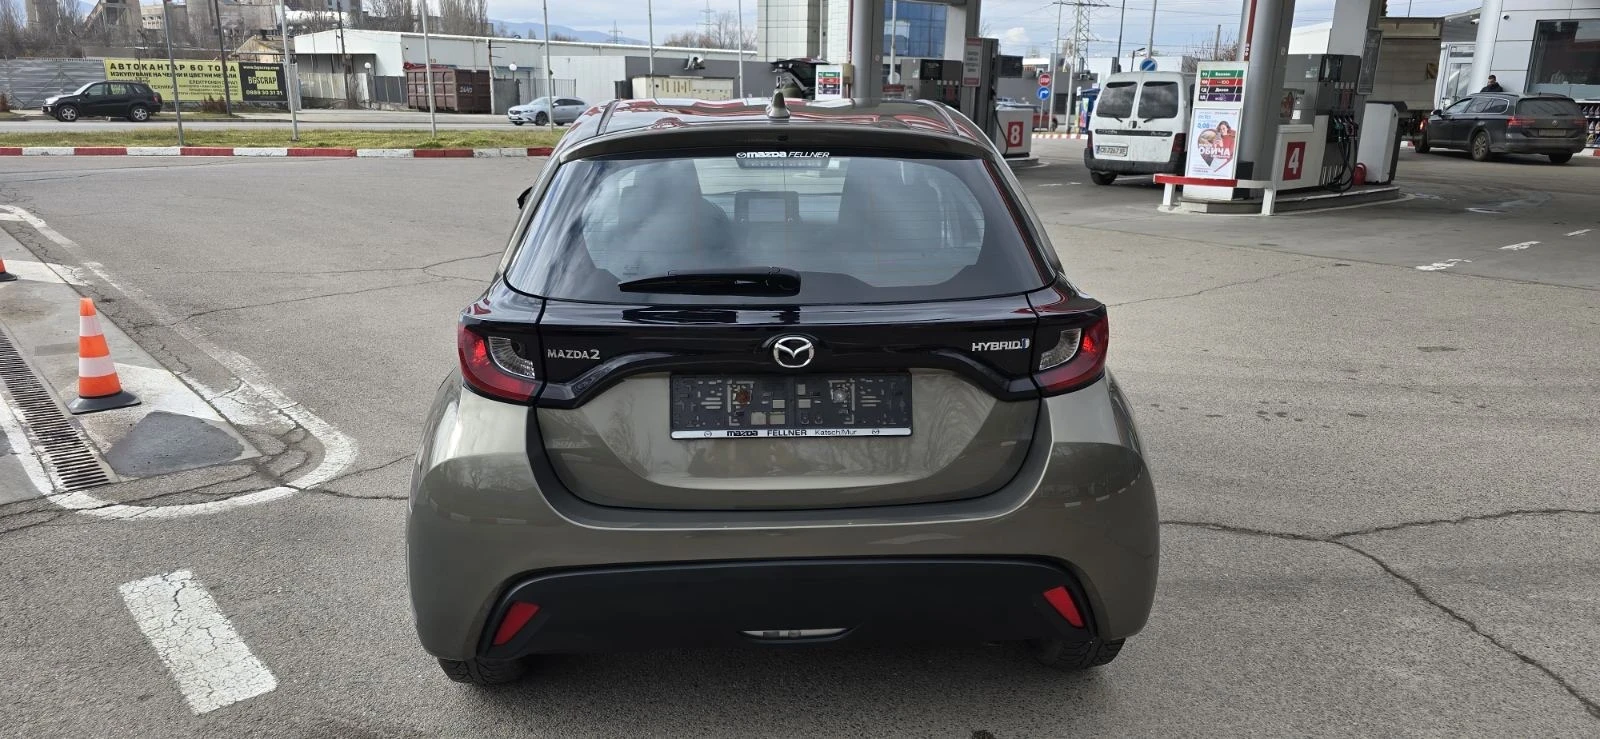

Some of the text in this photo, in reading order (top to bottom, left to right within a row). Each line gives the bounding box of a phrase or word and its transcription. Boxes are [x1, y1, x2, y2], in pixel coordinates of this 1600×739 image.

[190, 64, 204, 72] 60
[247, 76, 277, 85] BGSCRAP
[1010, 124, 1020, 145] 8
[1199, 146, 1231, 156] ОБИЧА
[1287, 147, 1301, 175] 4
[971, 340, 1021, 352] HYBRID
[767, 429, 807, 437] FELLNER
